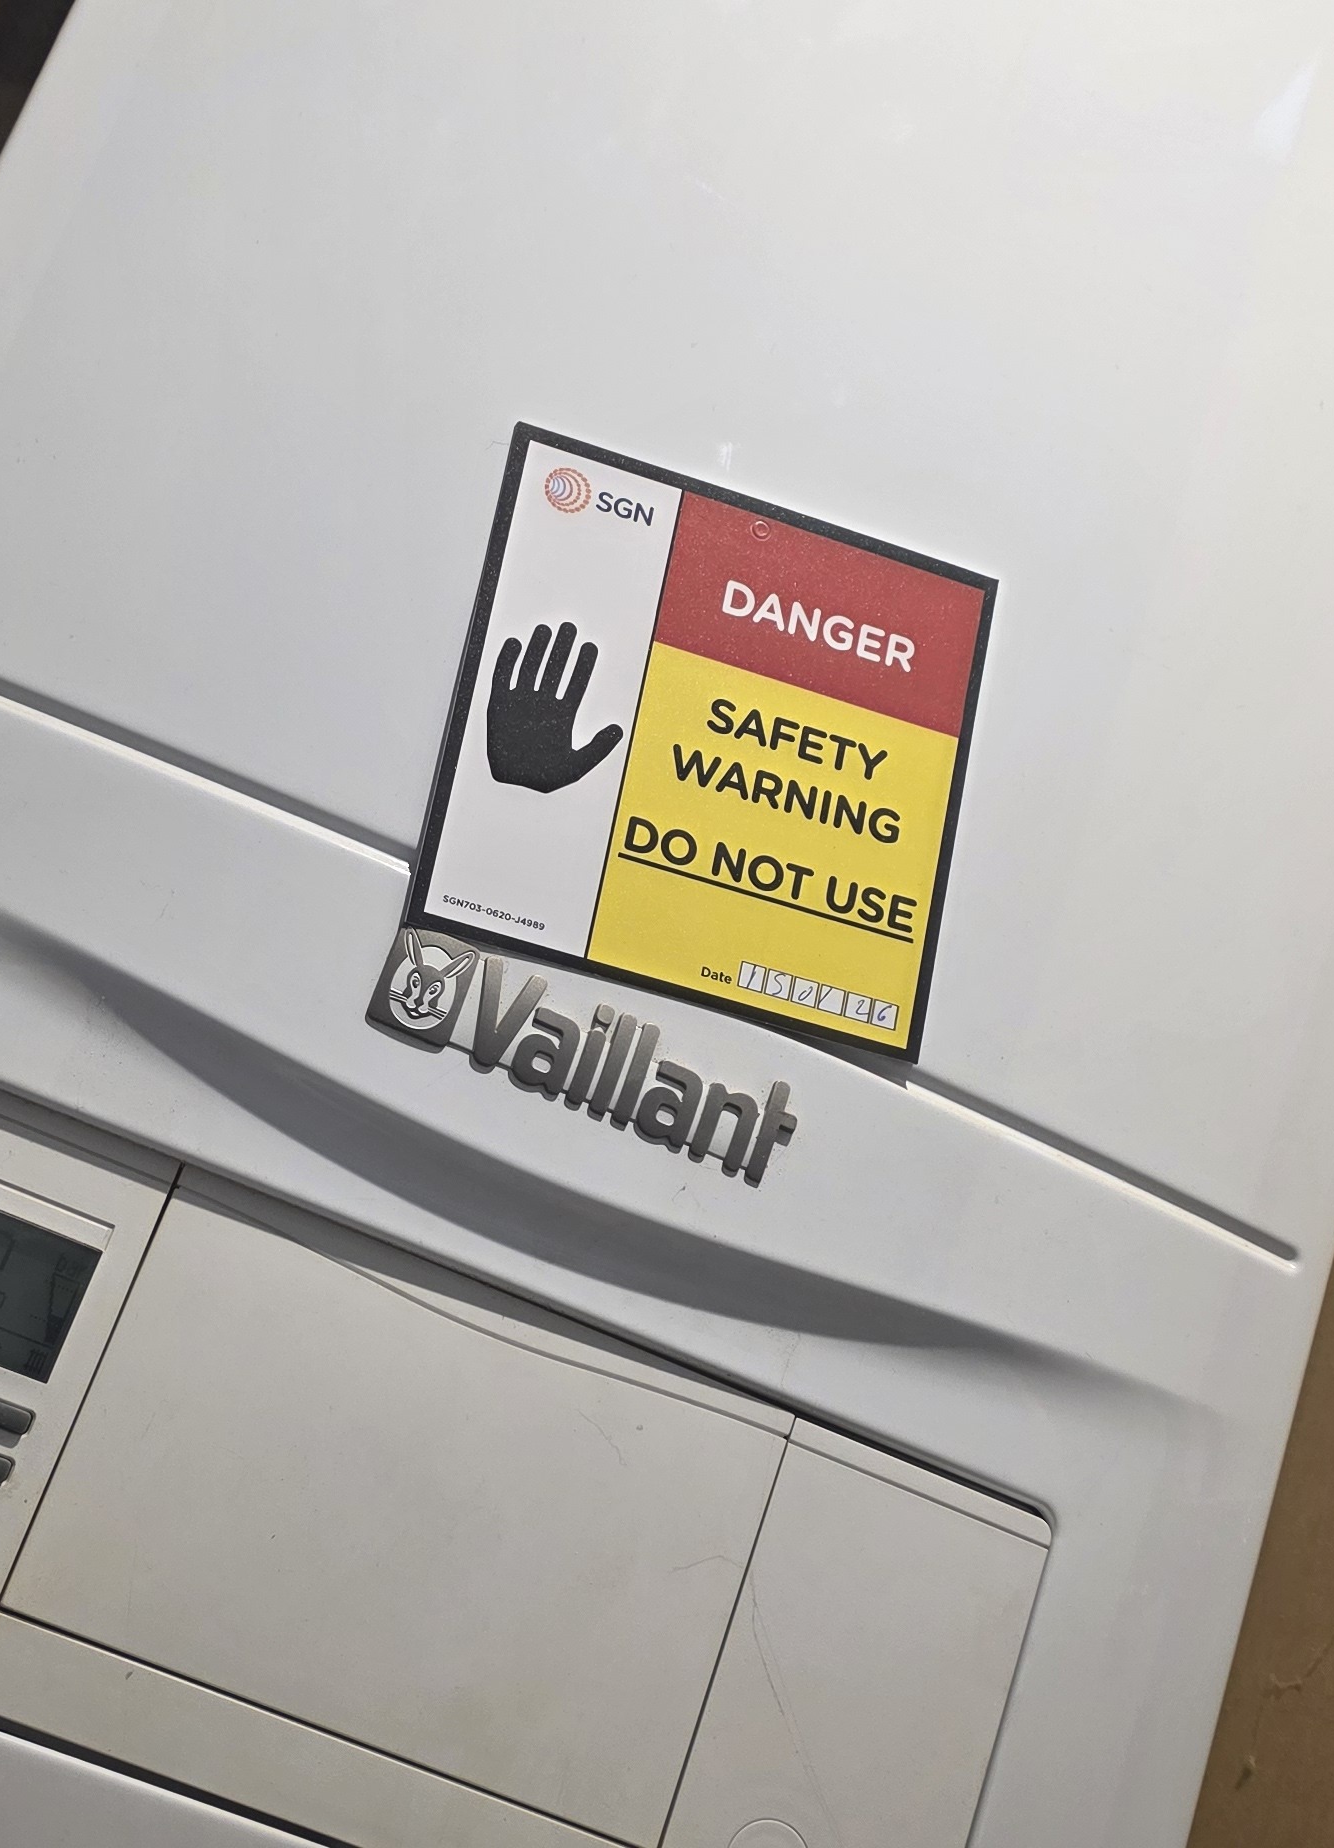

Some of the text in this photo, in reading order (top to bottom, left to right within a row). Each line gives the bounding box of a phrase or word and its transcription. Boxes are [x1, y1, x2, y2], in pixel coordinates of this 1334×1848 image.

[595, 491, 655, 527] SGN
[721, 579, 916, 673] DANGER
[706, 698, 888, 780] SAFETY
[672, 743, 901, 844] WARNING
[442, 894, 546, 931] SGN703-0620-J4989
[624, 815, 918, 933] DO NOT USE
[700, 966, 733, 985] Date
[469, 955, 798, 1188] Vaillant
